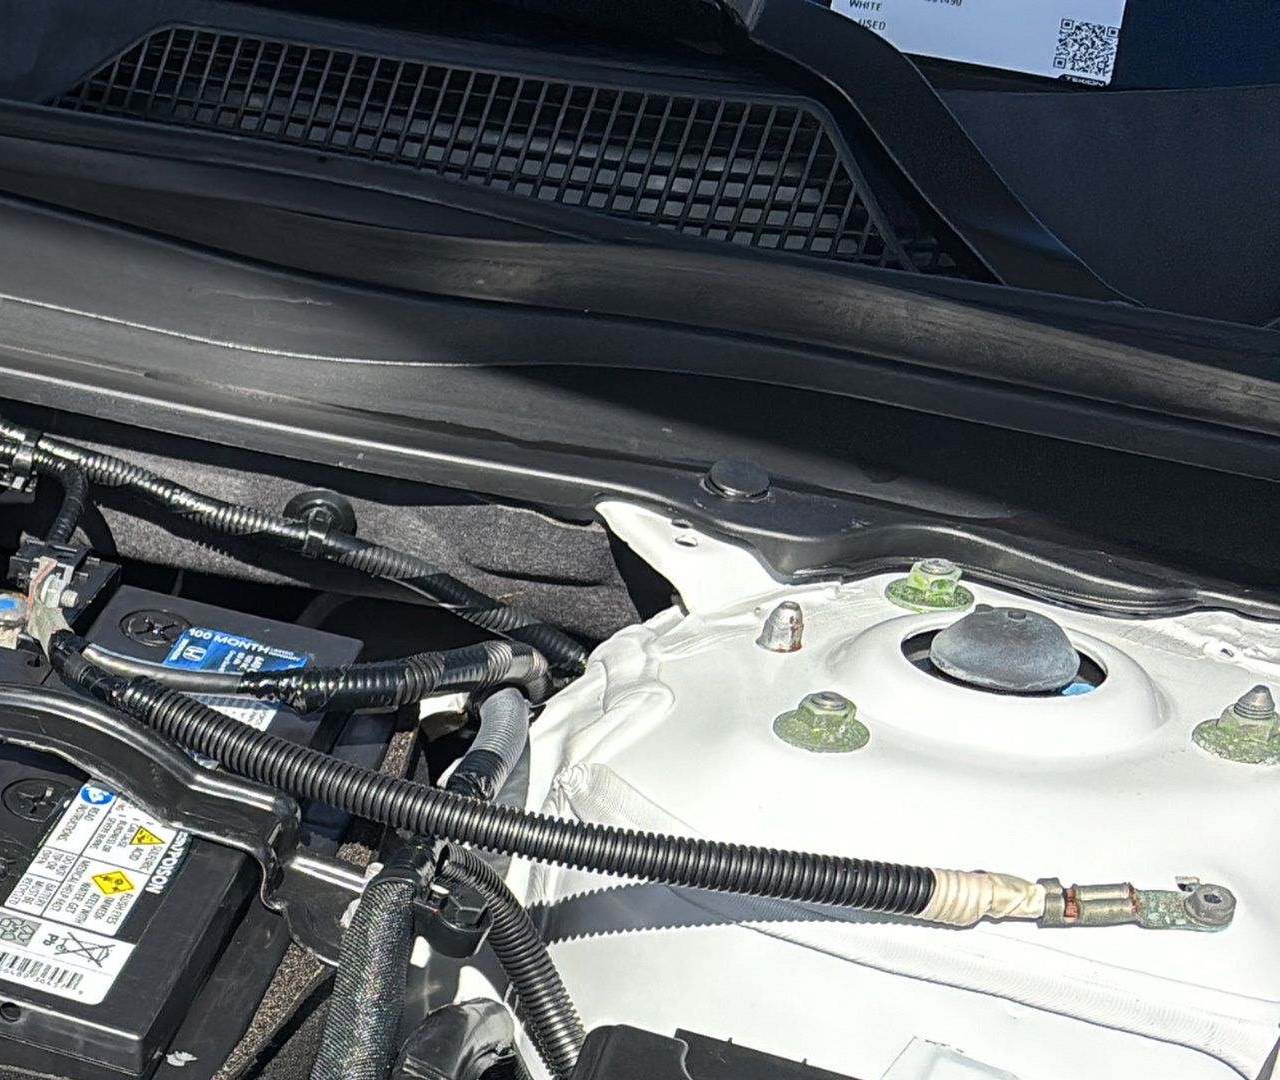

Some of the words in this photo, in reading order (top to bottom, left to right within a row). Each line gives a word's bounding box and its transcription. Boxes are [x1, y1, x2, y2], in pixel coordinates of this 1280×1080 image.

[849, 0, 881, 12] WHITE
[858, 18, 887, 31] USED
[189, 627, 213, 640] 100
[213, 635, 270, 654] MONTH
[83, 805, 100, 822] READ
[33, 882, 56, 908] BATTERY
[42, 933, 60, 946] Pb
